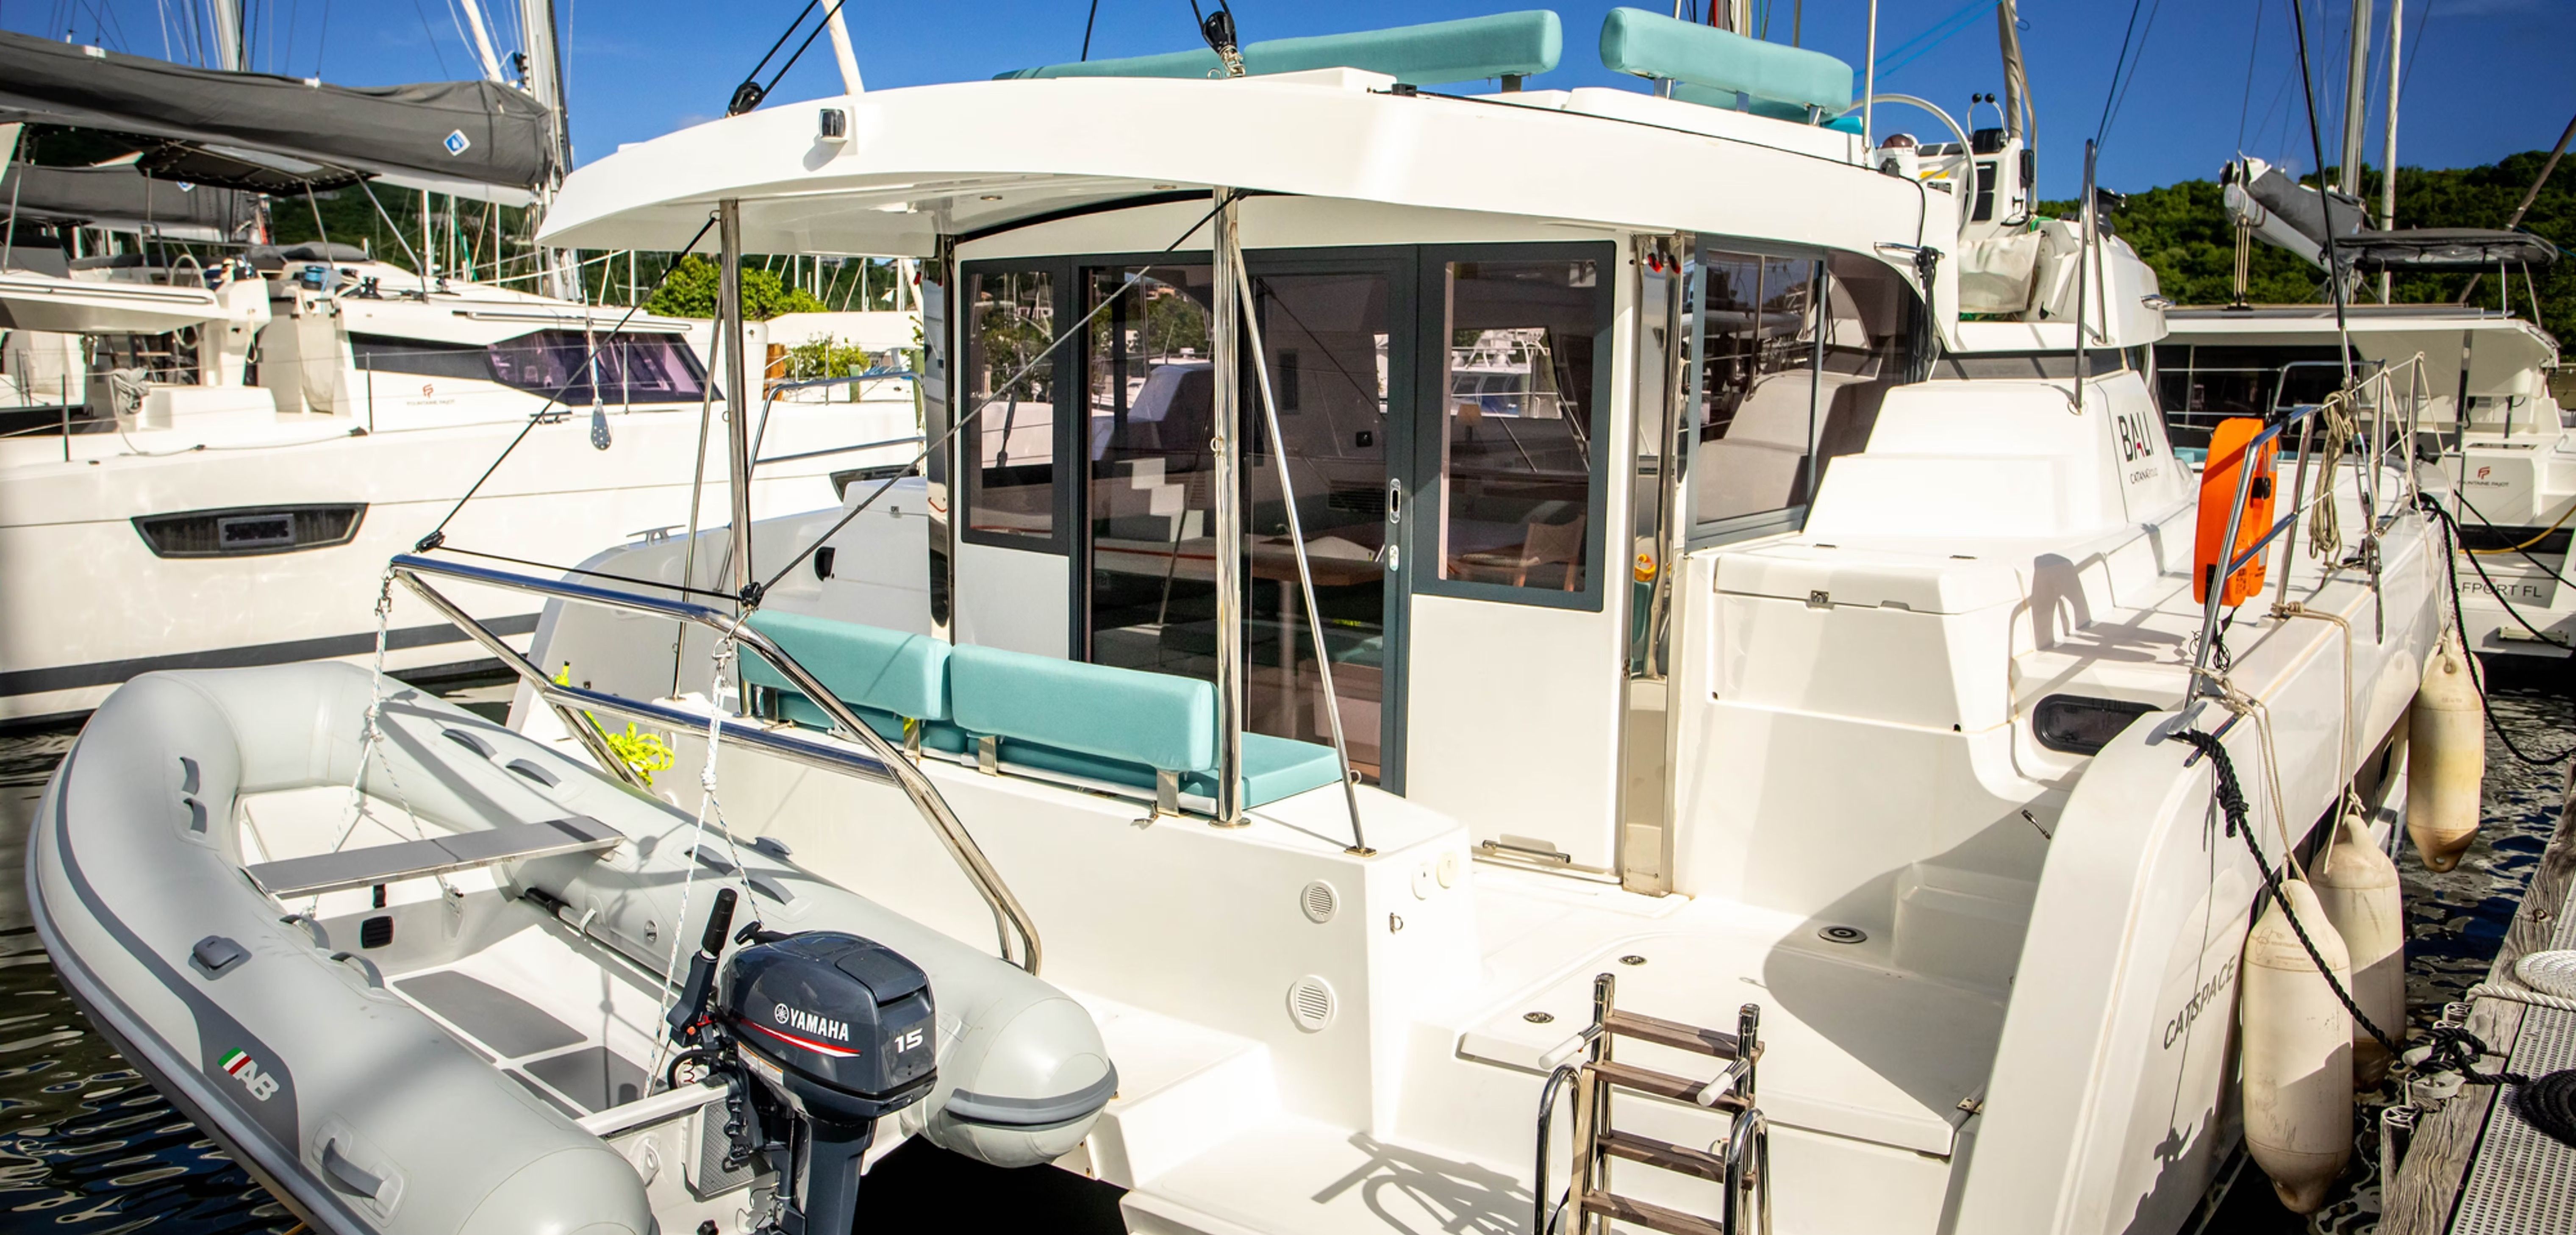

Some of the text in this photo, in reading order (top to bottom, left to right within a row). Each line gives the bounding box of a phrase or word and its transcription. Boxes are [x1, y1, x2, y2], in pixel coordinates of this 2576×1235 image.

[2118, 411, 2154, 462] BALI
[2458, 582, 2542, 598] FPORT FL
[2164, 954, 2236, 1050] CATSPACE
[790, 1007, 849, 1041] YAMAHA
[894, 1028, 923, 1053] 15
[233, 1060, 280, 1101] AB
